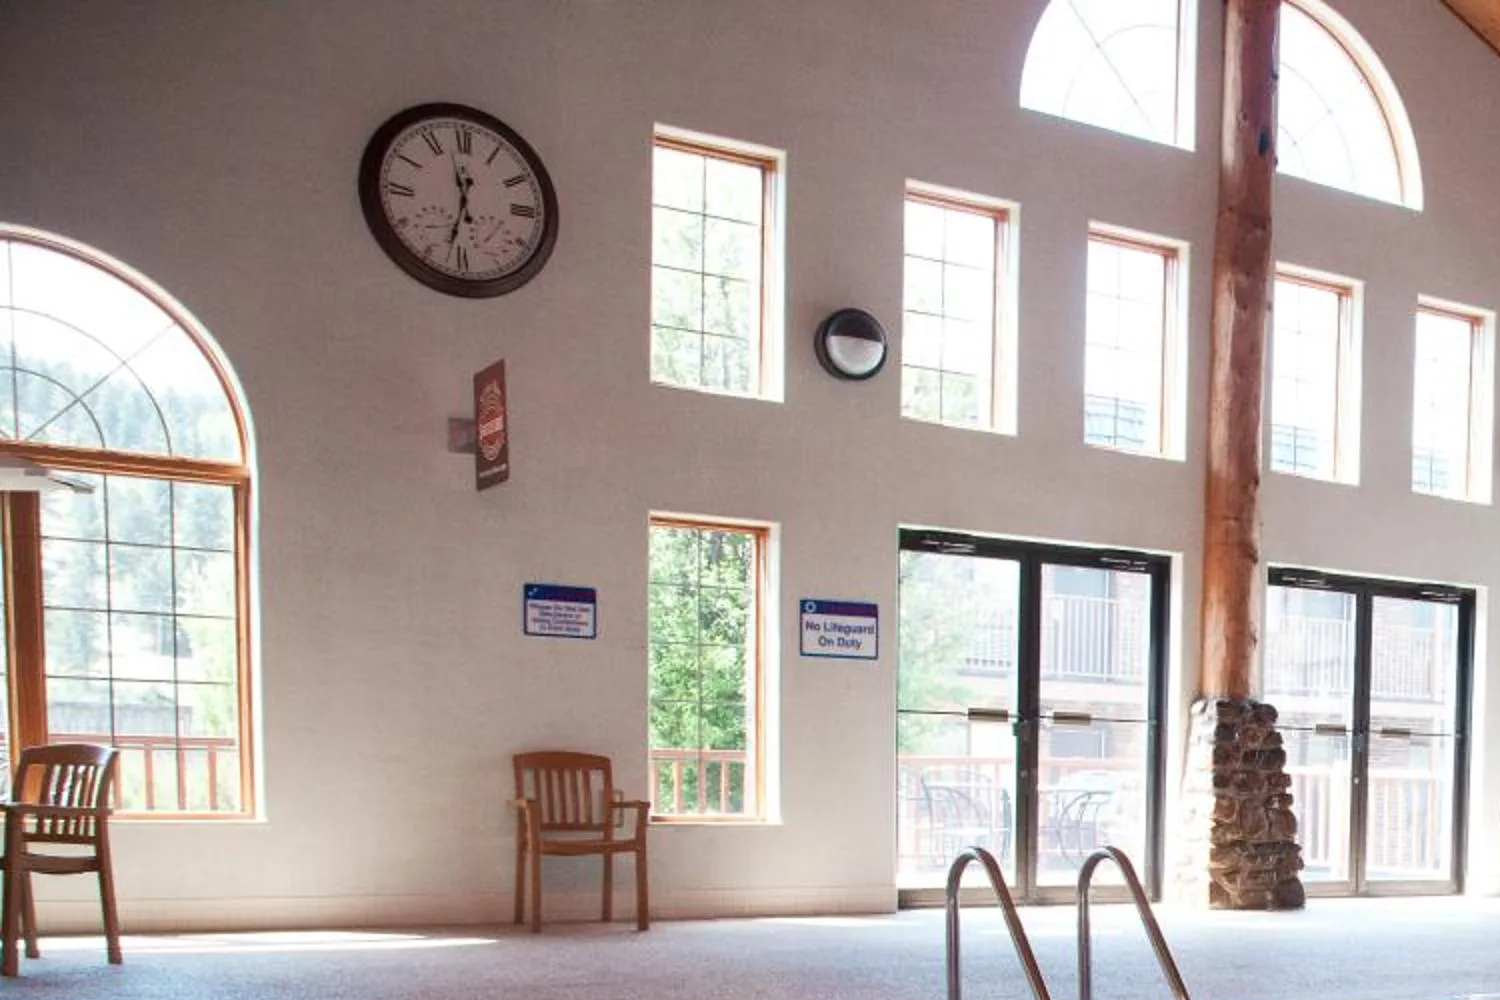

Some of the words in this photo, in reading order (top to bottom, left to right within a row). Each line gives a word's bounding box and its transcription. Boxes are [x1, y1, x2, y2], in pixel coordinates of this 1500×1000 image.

[805, 621, 821, 631] No
[823, 621, 875, 637] Lifeguard
[818, 635, 835, 647] On
[837, 637, 863, 651] Duty
